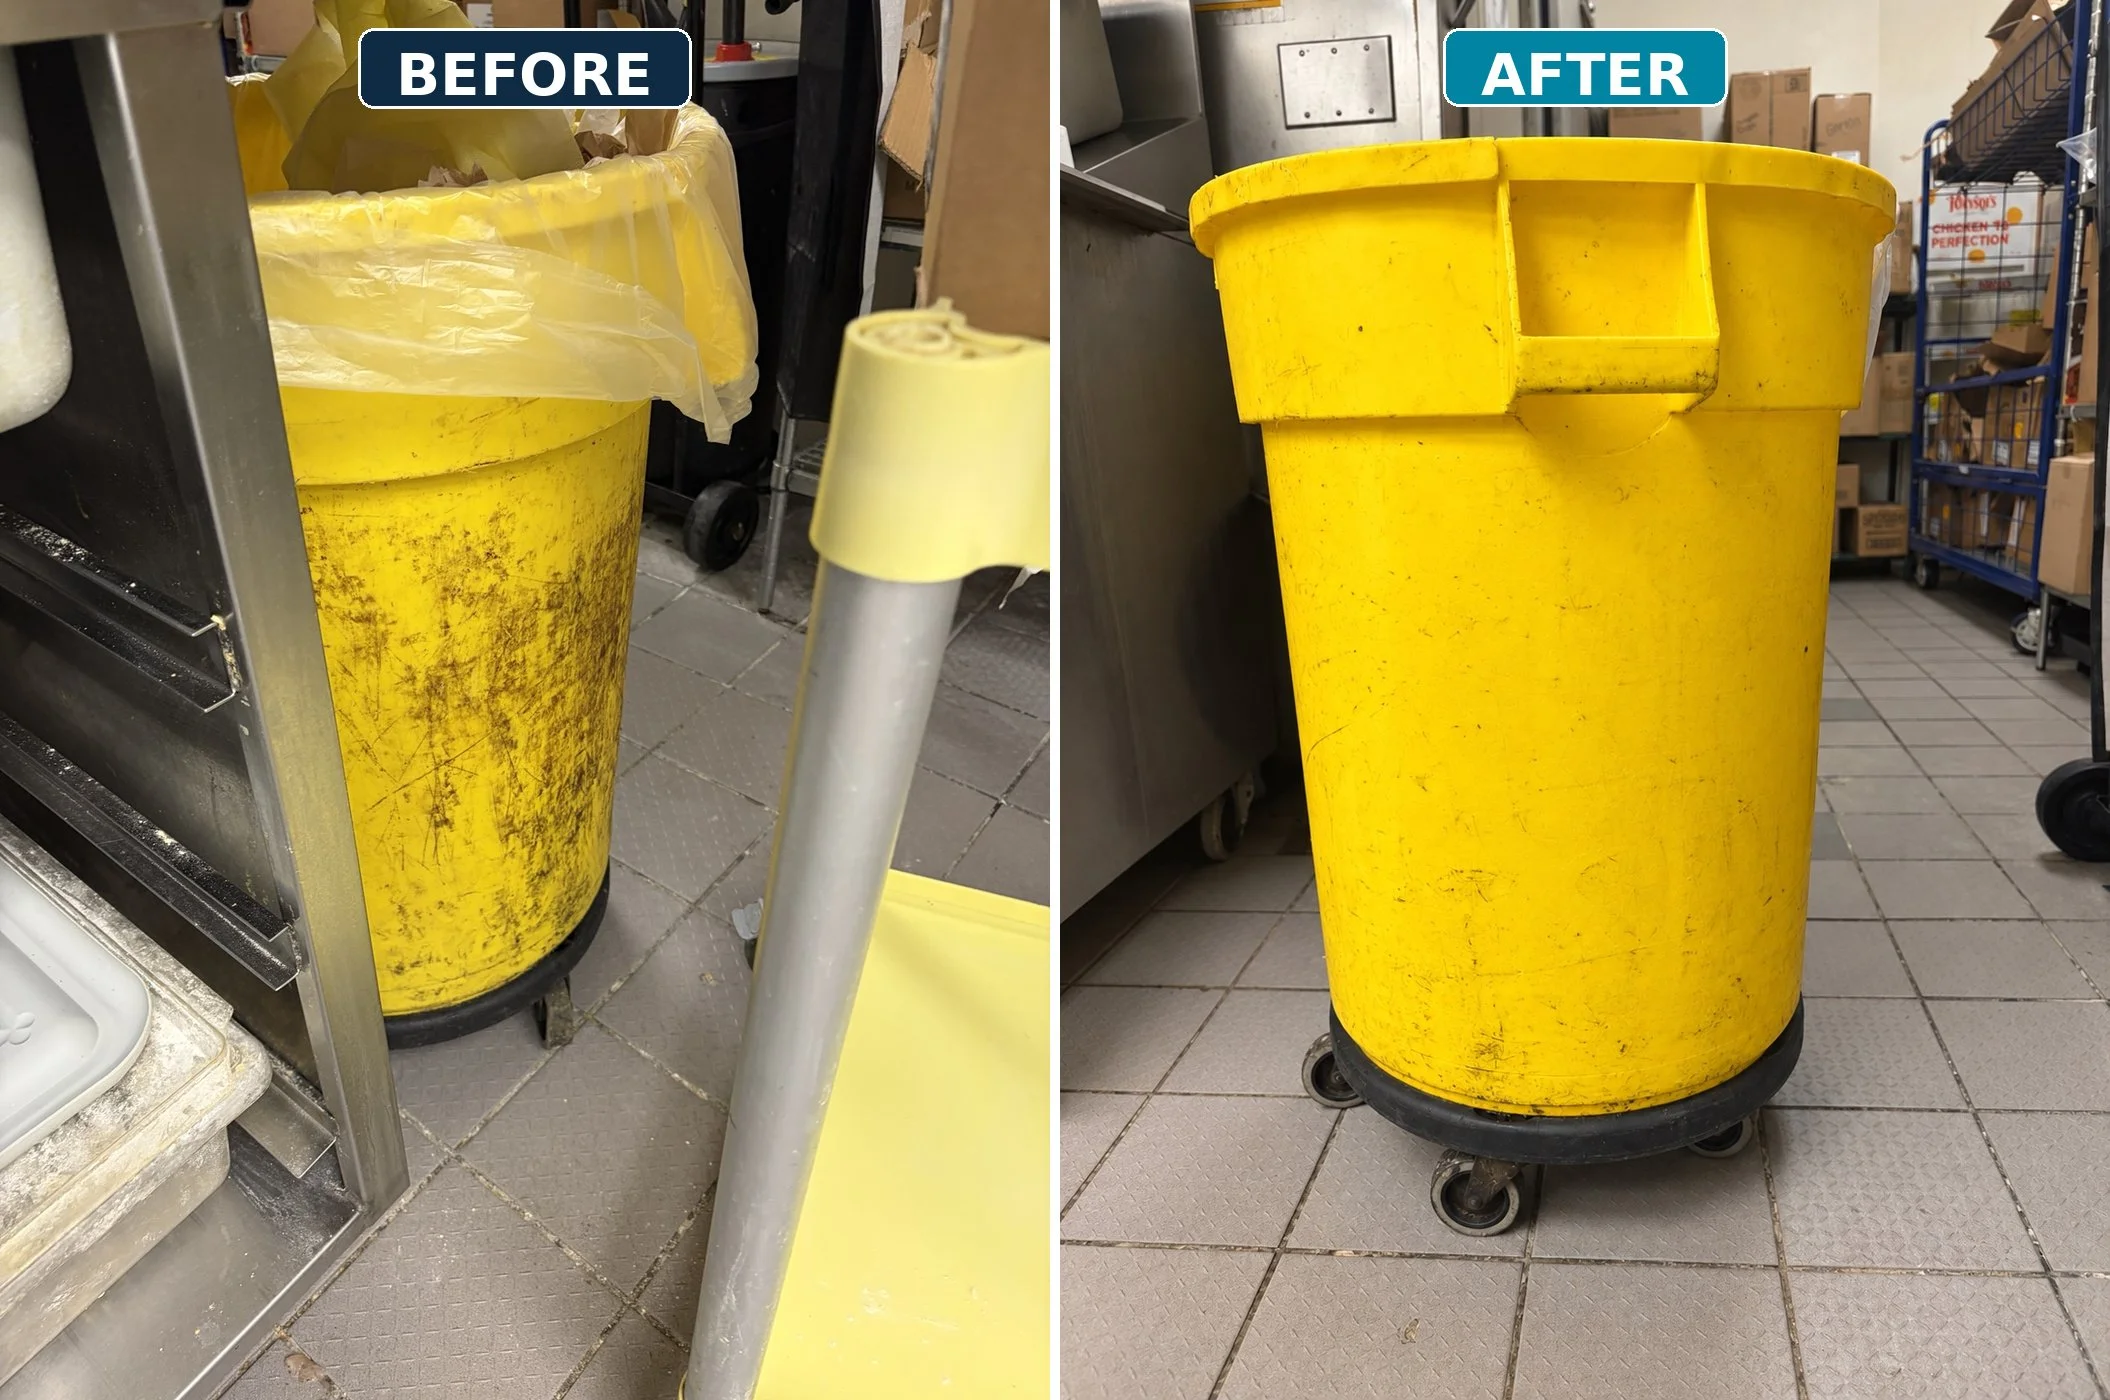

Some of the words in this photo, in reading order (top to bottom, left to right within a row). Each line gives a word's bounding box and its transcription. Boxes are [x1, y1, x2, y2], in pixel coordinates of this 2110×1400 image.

[1932, 221, 1988, 234] CHICKEN
[1993, 220, 2009, 231] TO
[1931, 234, 2009, 248] PERFECTION
